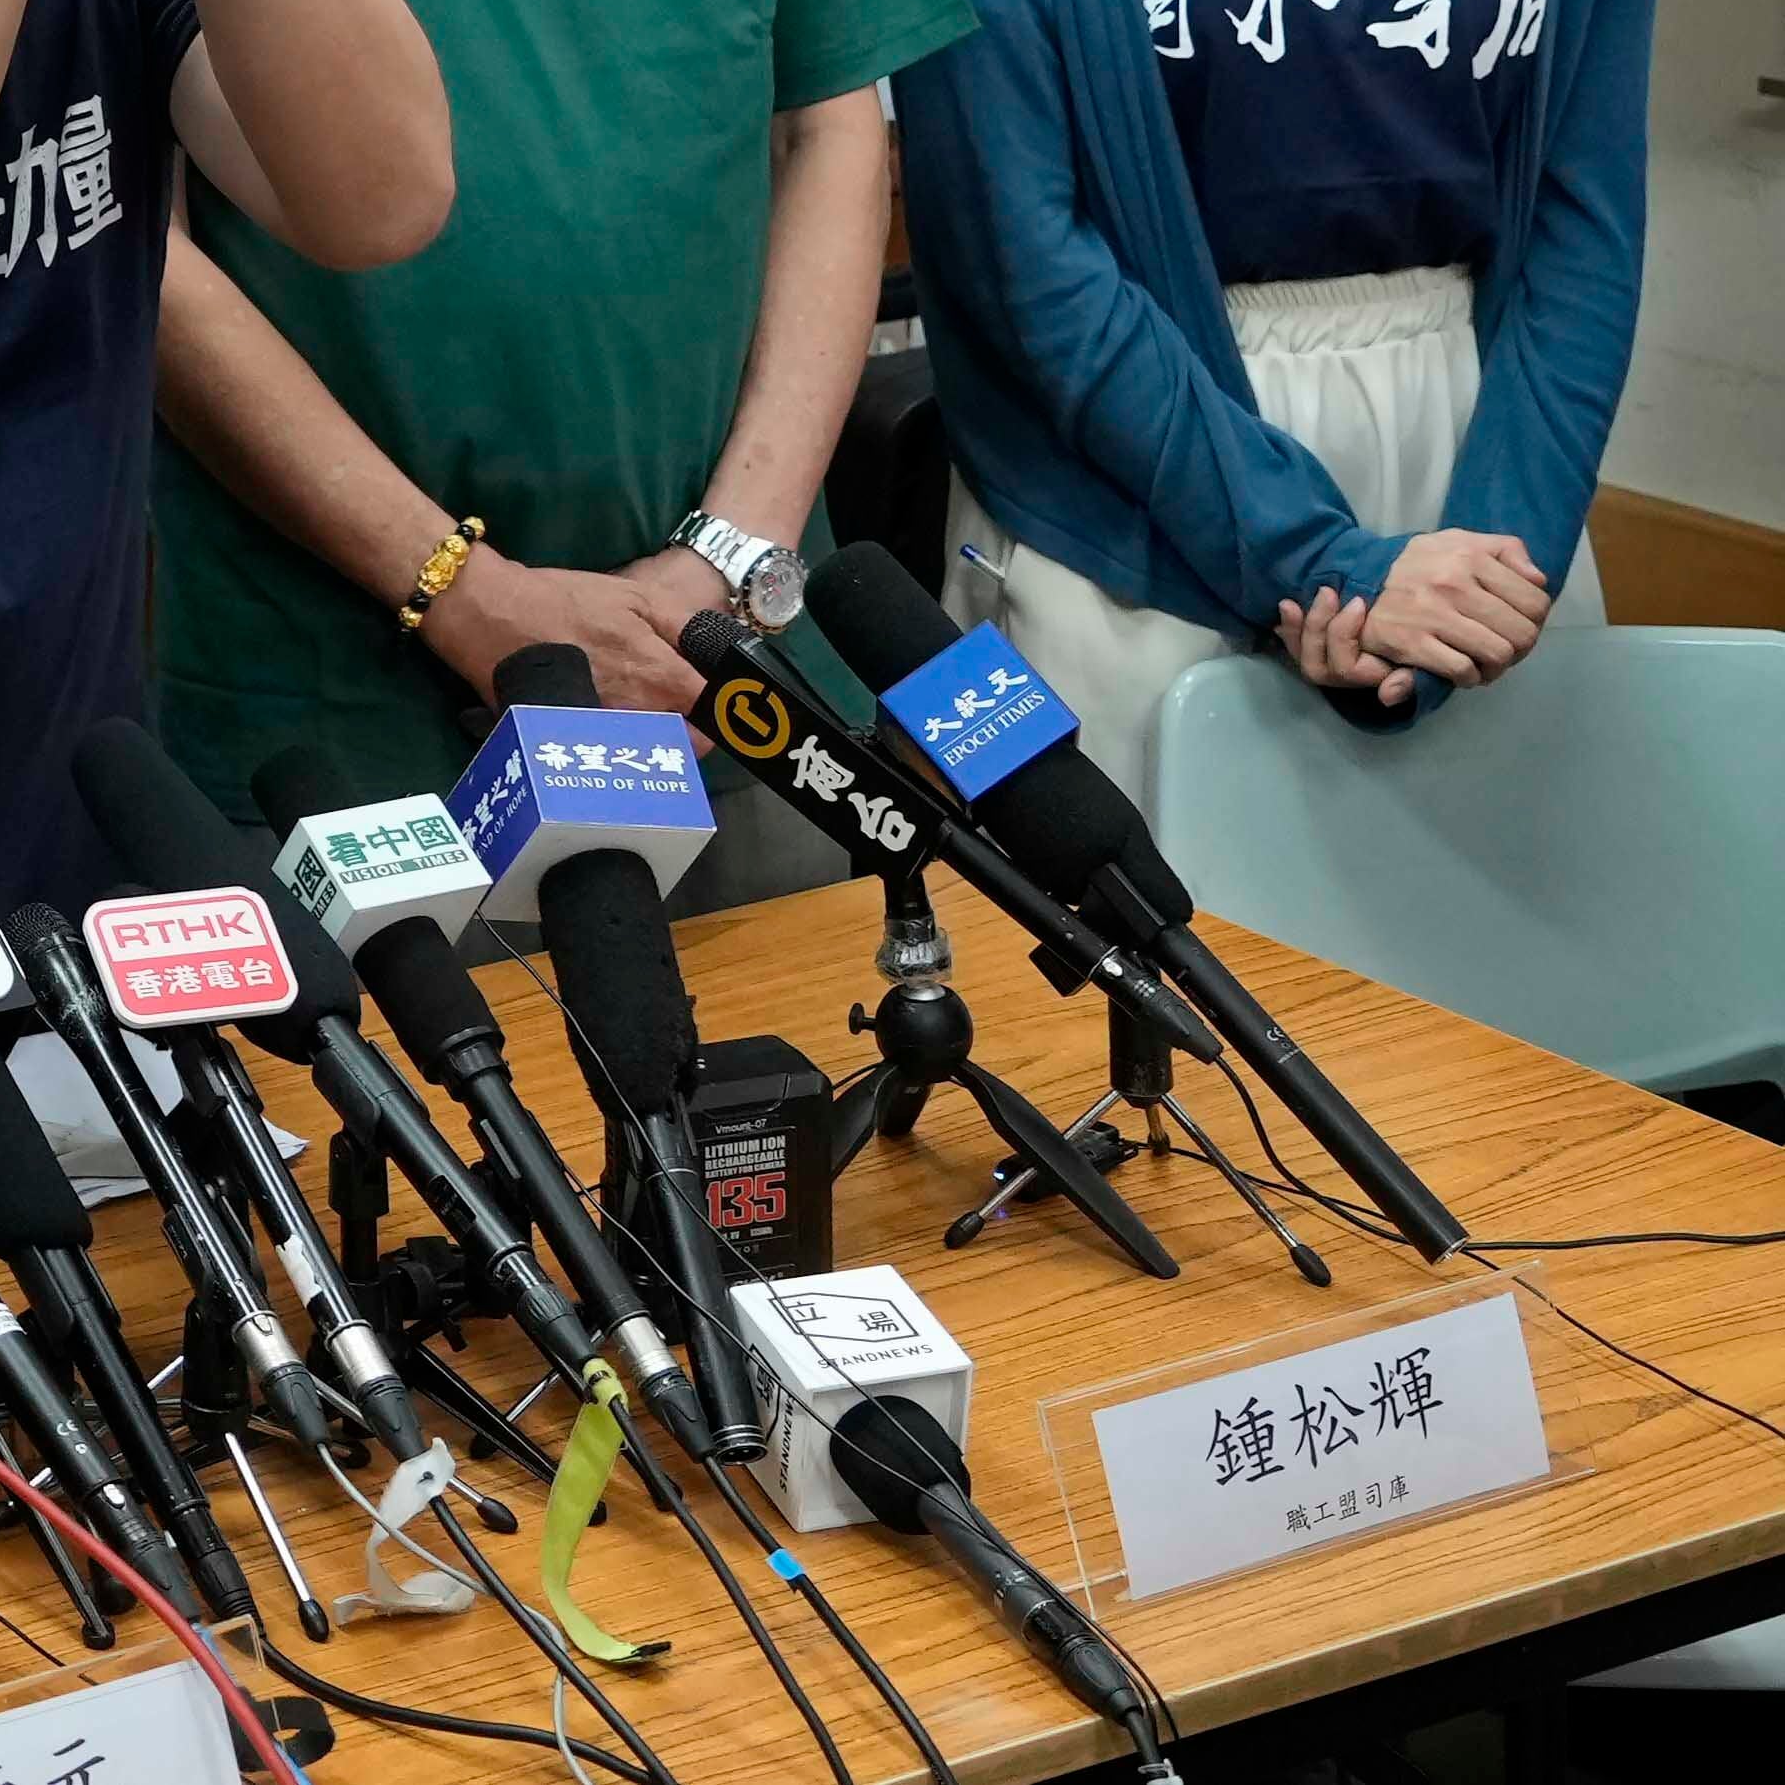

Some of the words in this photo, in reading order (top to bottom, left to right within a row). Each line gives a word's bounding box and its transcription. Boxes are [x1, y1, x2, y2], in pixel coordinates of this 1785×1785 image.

[924, 667, 1028, 742] 大紀元
[943, 722, 1000, 767] EPOCH
[995, 690, 1046, 729] TIMES
[544, 775, 607, 789] SOUND
[612, 778, 635, 790] OF
[643, 779, 690, 793] HOPE
[788, 734, 916, 851] 商台
[326, 815, 458, 867] 看中國
[340, 863, 403, 884] VISION
[414, 850, 466, 871] TIMES
[111, 912, 256, 950] RTHK
[126, 958, 274, 999] 香港電台
[705, 1139, 761, 1159] LITHIUM
[762, 1135, 786, 1151] ION
[705, 1149, 785, 1171] RECHARGEABLE
[706, 1171, 787, 1229] 135
[817, 1343, 934, 1369] STANDNEWS
[1206, 1347, 1444, 1486] 鍾松輝
[1286, 1474, 1410, 1533] 職工盟司庫
